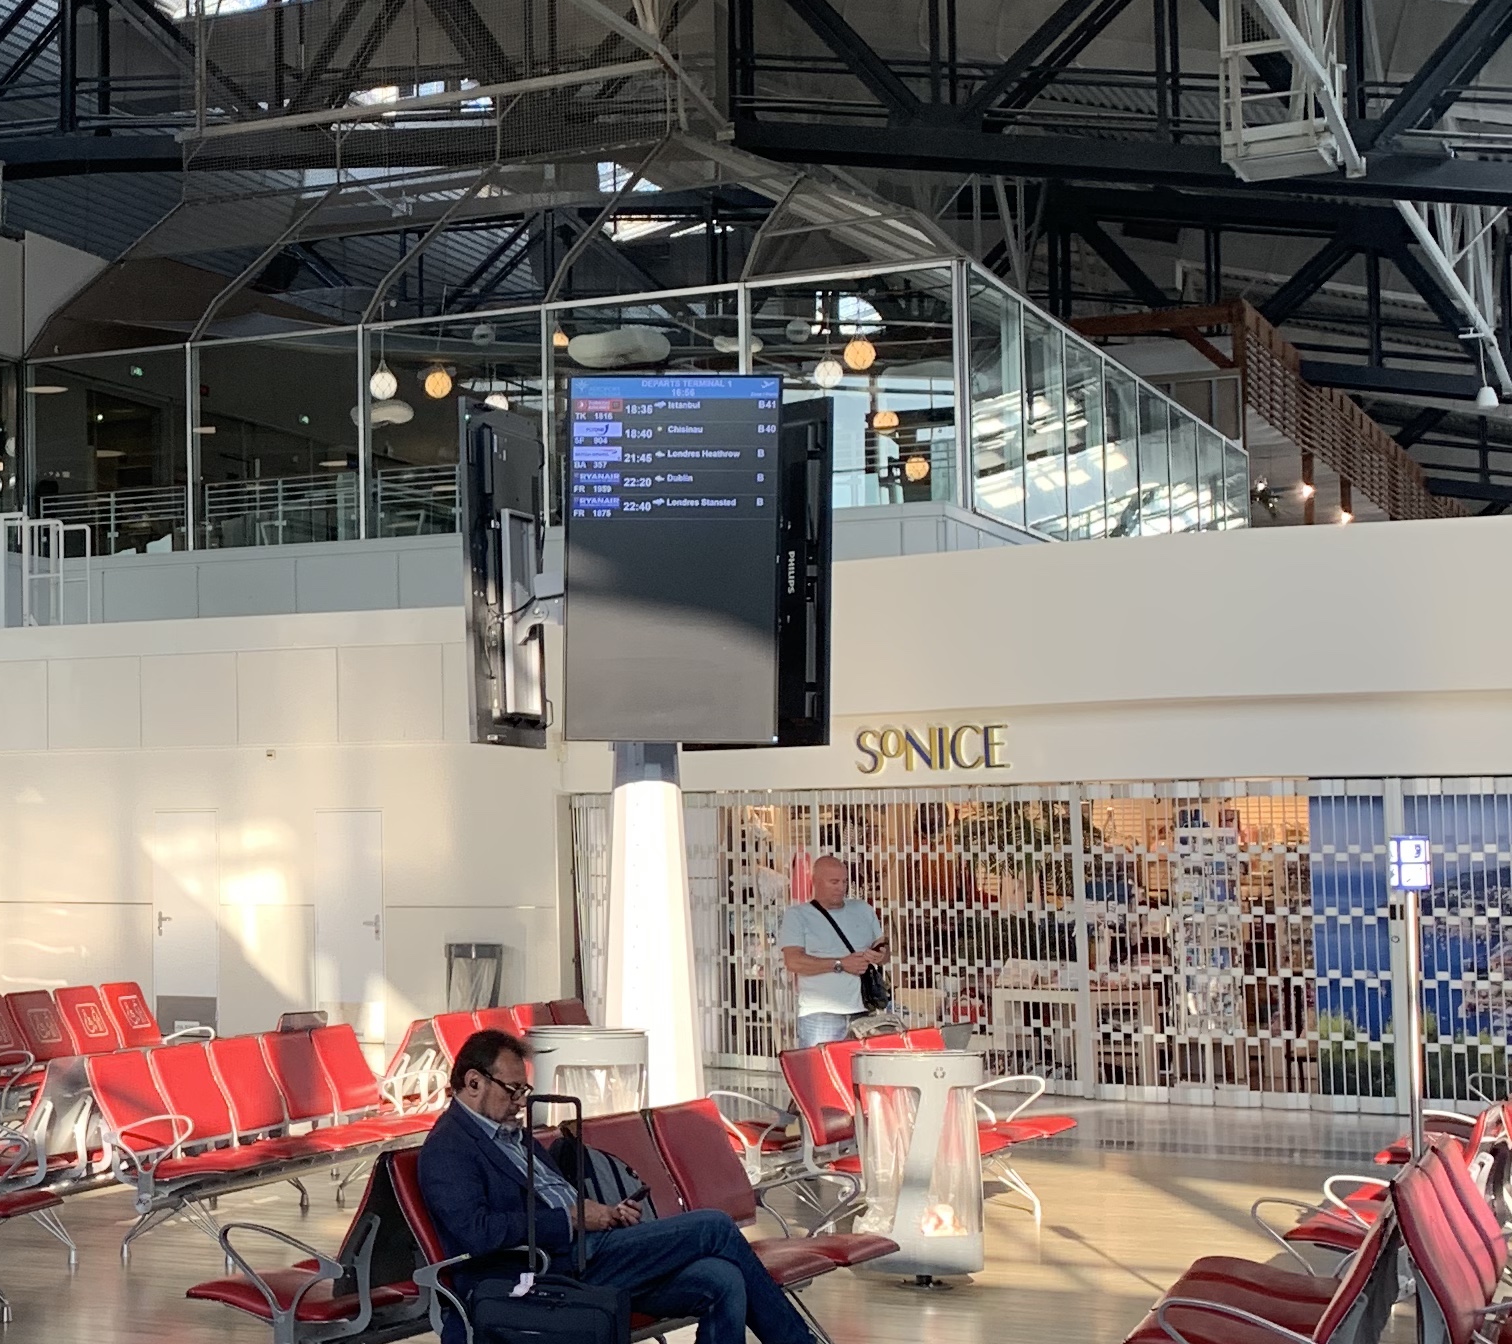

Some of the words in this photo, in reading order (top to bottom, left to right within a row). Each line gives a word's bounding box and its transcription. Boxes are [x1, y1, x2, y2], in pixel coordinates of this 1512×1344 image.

[668, 401, 700, 409] Istanbul
[758, 400, 776, 409] B41
[575, 412, 587, 420] TK
[625, 428, 653, 439] 18:40
[668, 425, 703, 434] Chisinau
[757, 425, 777, 433] B40
[668, 449, 700, 458] Londres
[702, 449, 740, 458] Heathrow
[757, 448, 765, 458] B
[574, 460, 587, 469] BA
[580, 472, 620, 480] RYANAIR
[623, 477, 652, 487] 22:20
[667, 474, 693, 482] Dublin
[756, 473, 764, 482] B
[573, 485, 585, 493] FR
[623, 501, 652, 512] 22:40
[667, 498, 700, 506] Londres
[701, 498, 737, 507] Stansted
[756, 497, 764, 506] B
[573, 509, 585, 517] FR
[788, 550, 796, 594] PHILIPS
